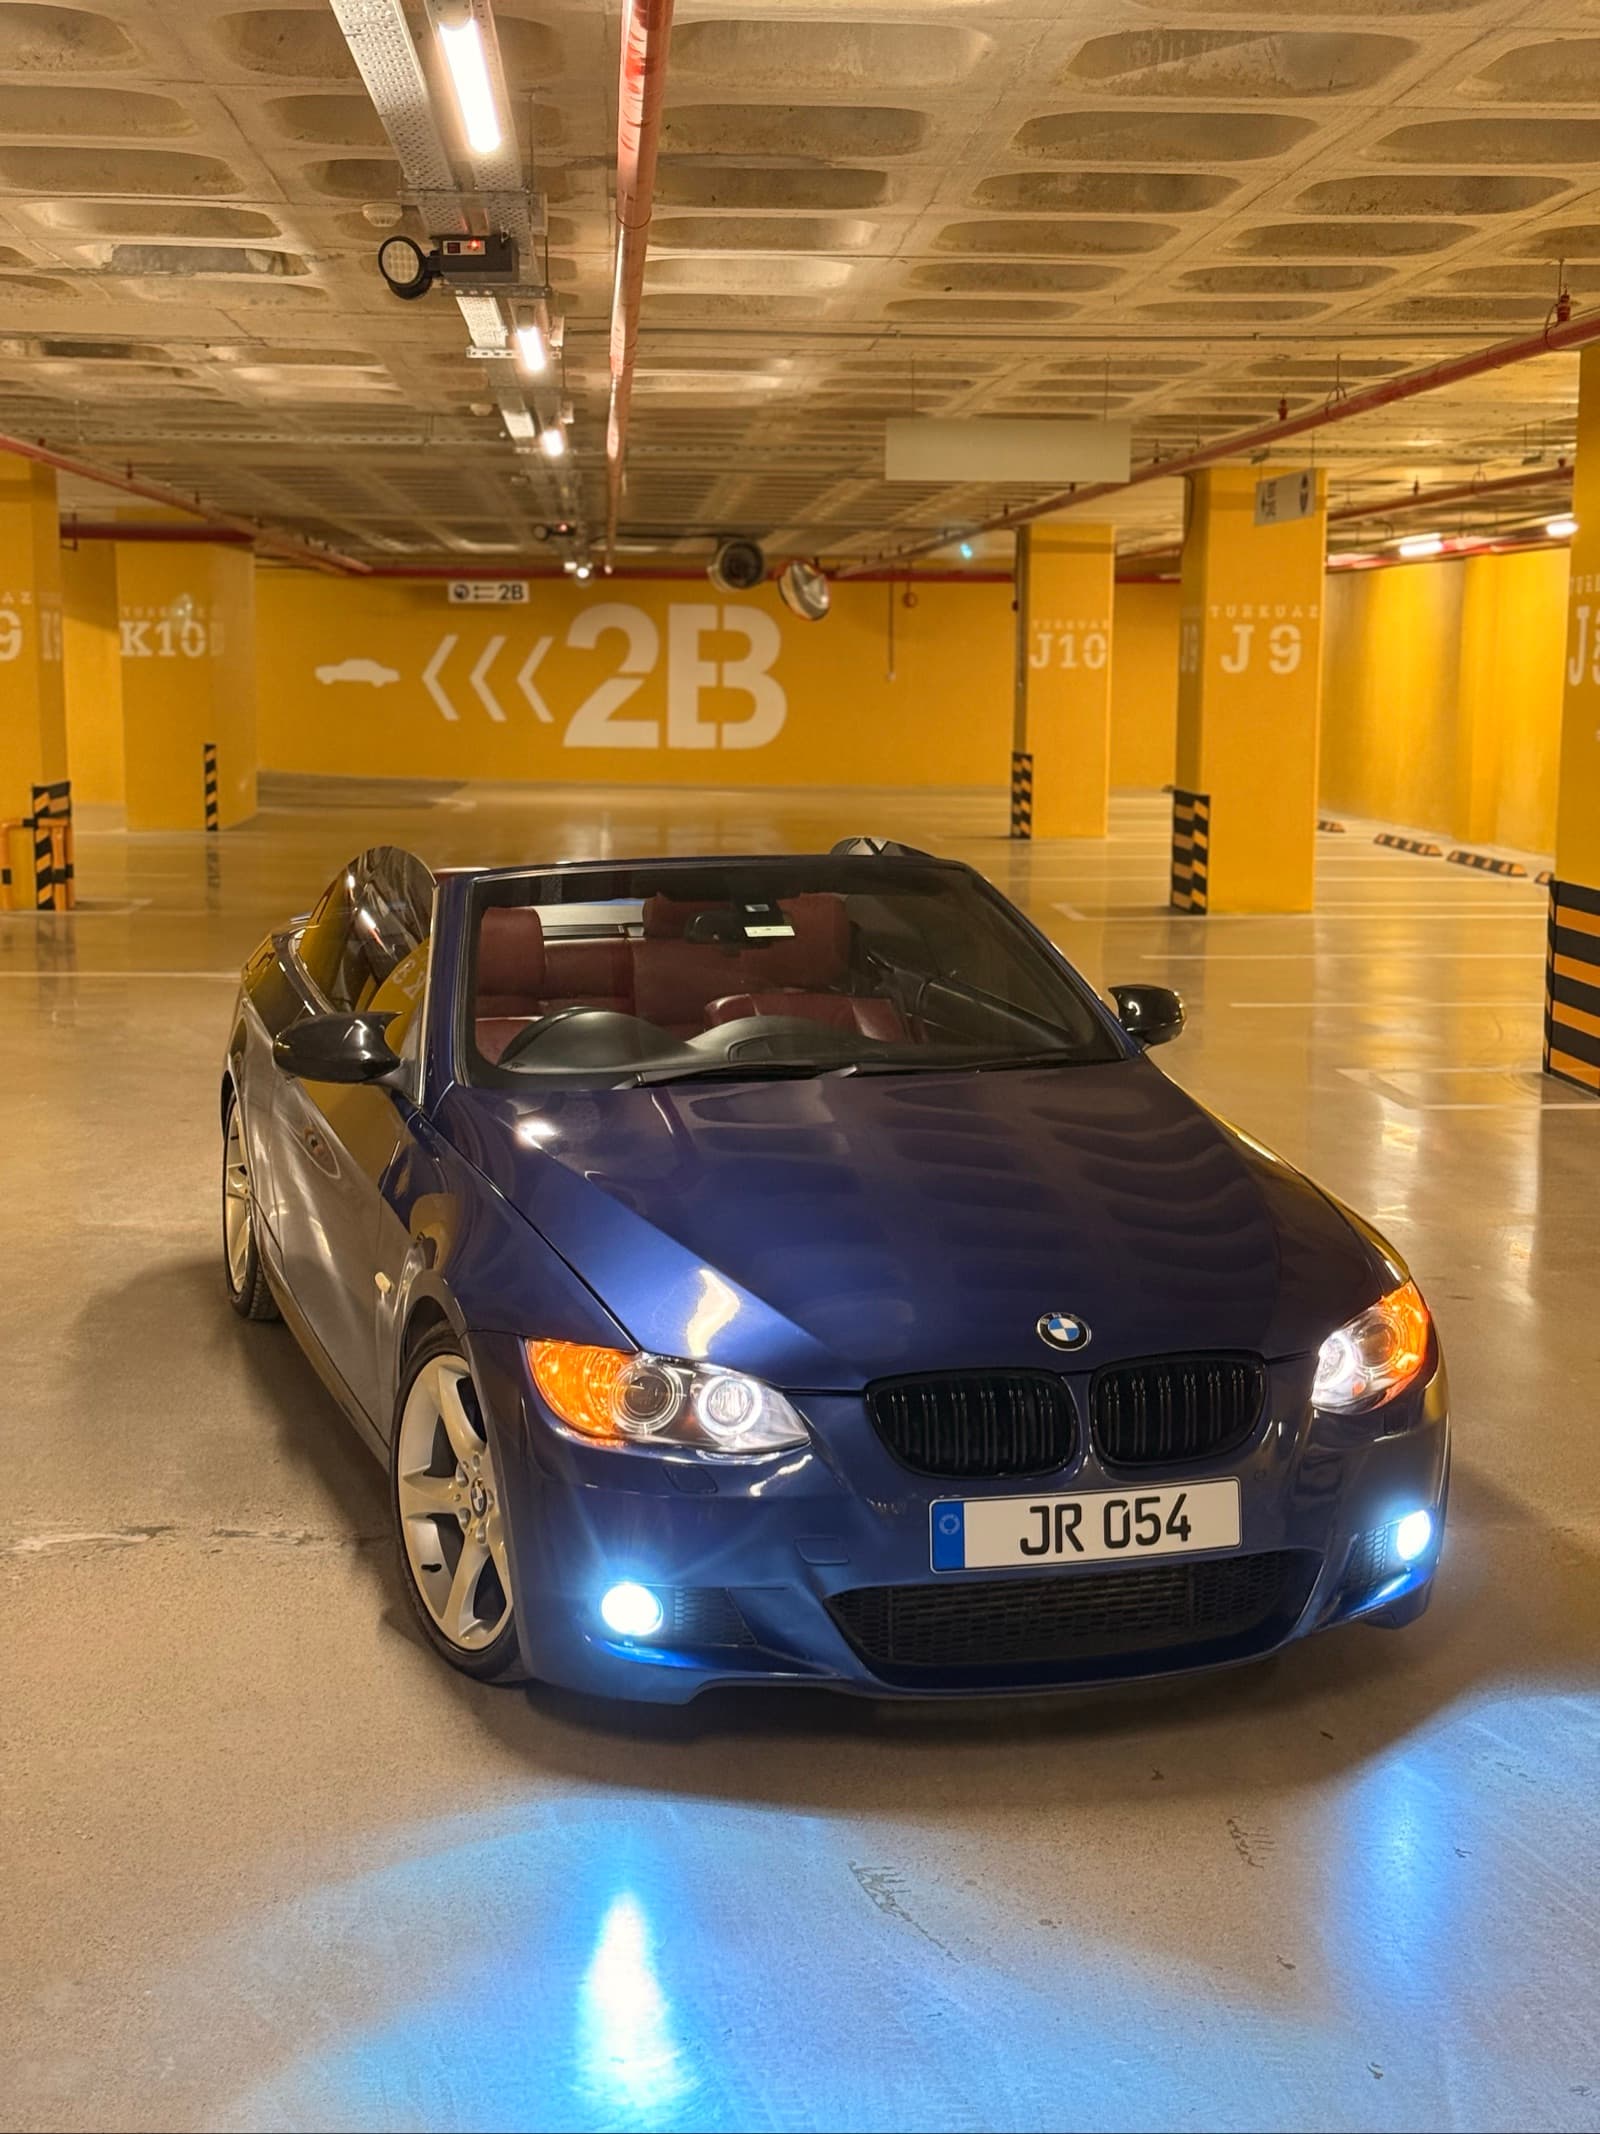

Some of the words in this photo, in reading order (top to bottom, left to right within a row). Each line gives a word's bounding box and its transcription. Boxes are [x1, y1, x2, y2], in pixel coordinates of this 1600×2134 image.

[498, 584, 524, 600] 2B
[119, 621, 206, 658] K10
[1028, 632, 1107, 670] J10
[563, 602, 788, 749] 2B
[1019, 1503, 1086, 1556] JR
[1102, 1493, 1192, 1549] 054
